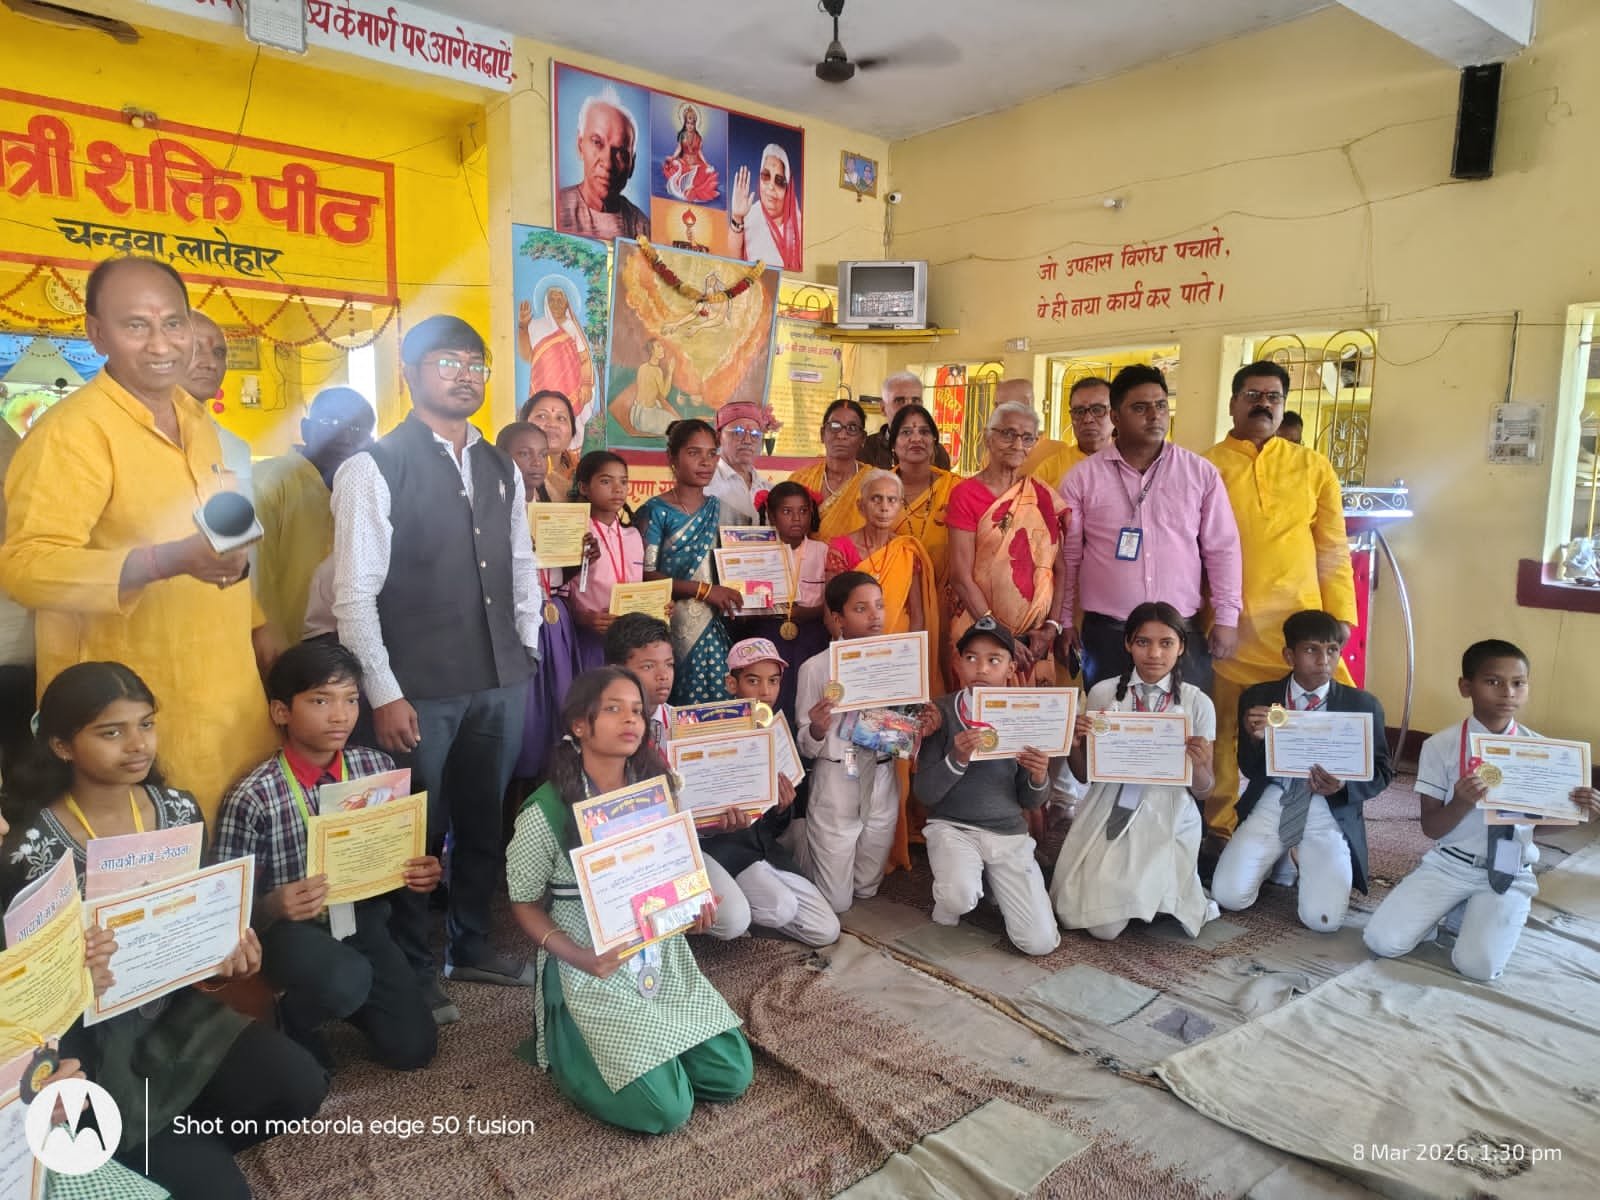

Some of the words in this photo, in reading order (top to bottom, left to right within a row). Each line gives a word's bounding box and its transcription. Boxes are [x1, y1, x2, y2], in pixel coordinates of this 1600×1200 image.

[401, 23, 428, 61] पर
[85, 138, 242, 222] शक्ति
[252, 162, 380, 245] पीठ
[1039, 256, 1058, 280] जो
[1066, 252, 1113, 277] उपहास
[1121, 240, 1168, 269] विरोध
[1050, 293, 1067, 322] ही
[1071, 296, 1102, 317] नया
[1106, 280, 1143, 312] कार्य
[1146, 287, 1171, 309] कर
